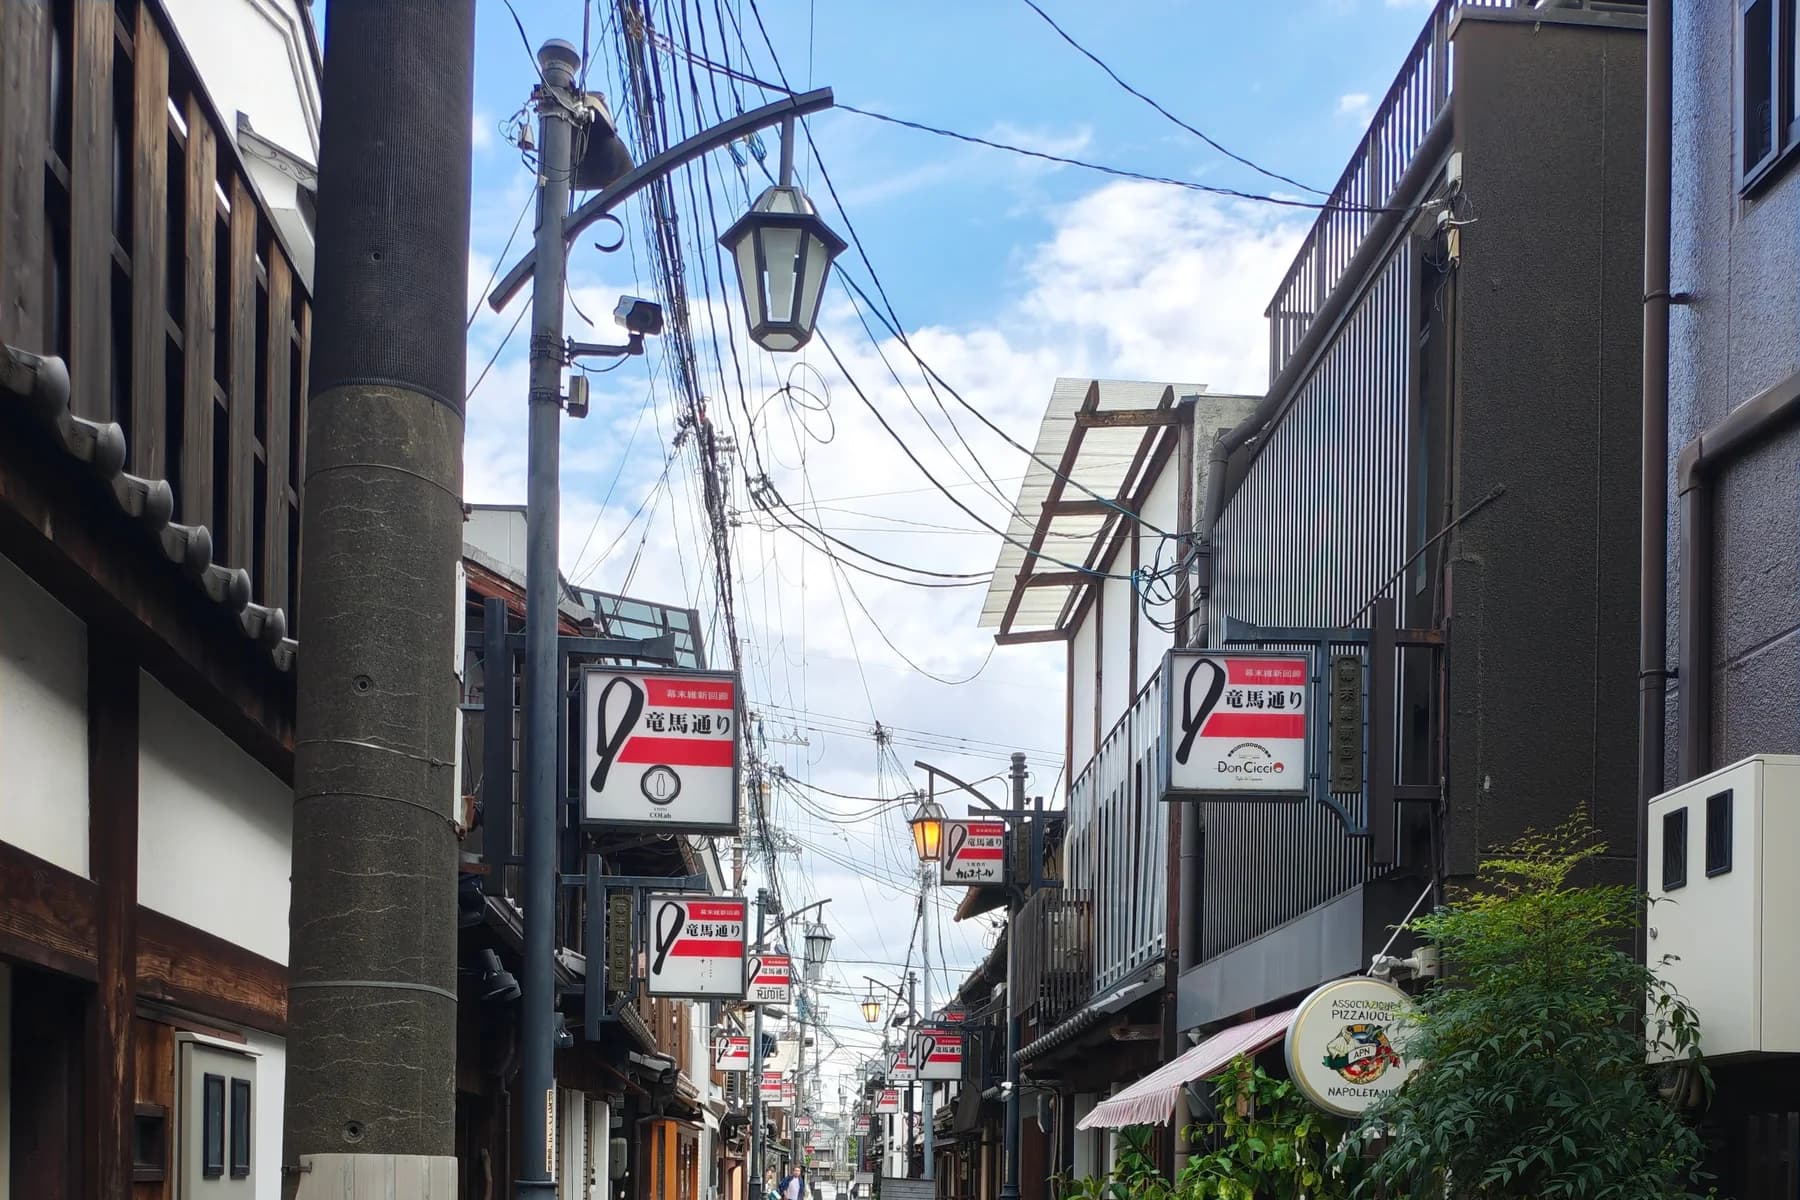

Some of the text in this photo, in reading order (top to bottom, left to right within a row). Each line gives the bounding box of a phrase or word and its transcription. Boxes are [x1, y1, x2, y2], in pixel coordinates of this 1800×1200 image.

[666, 688, 729, 701] 幕末維新回廊
[1225, 689, 1302, 709] 竜馬通り
[645, 711, 730, 735] 竜馬通り
[1217, 760, 1242, 773] Don
[686, 923, 740, 938] 竜馬通り
[1353, 1047, 1371, 1059] APN
